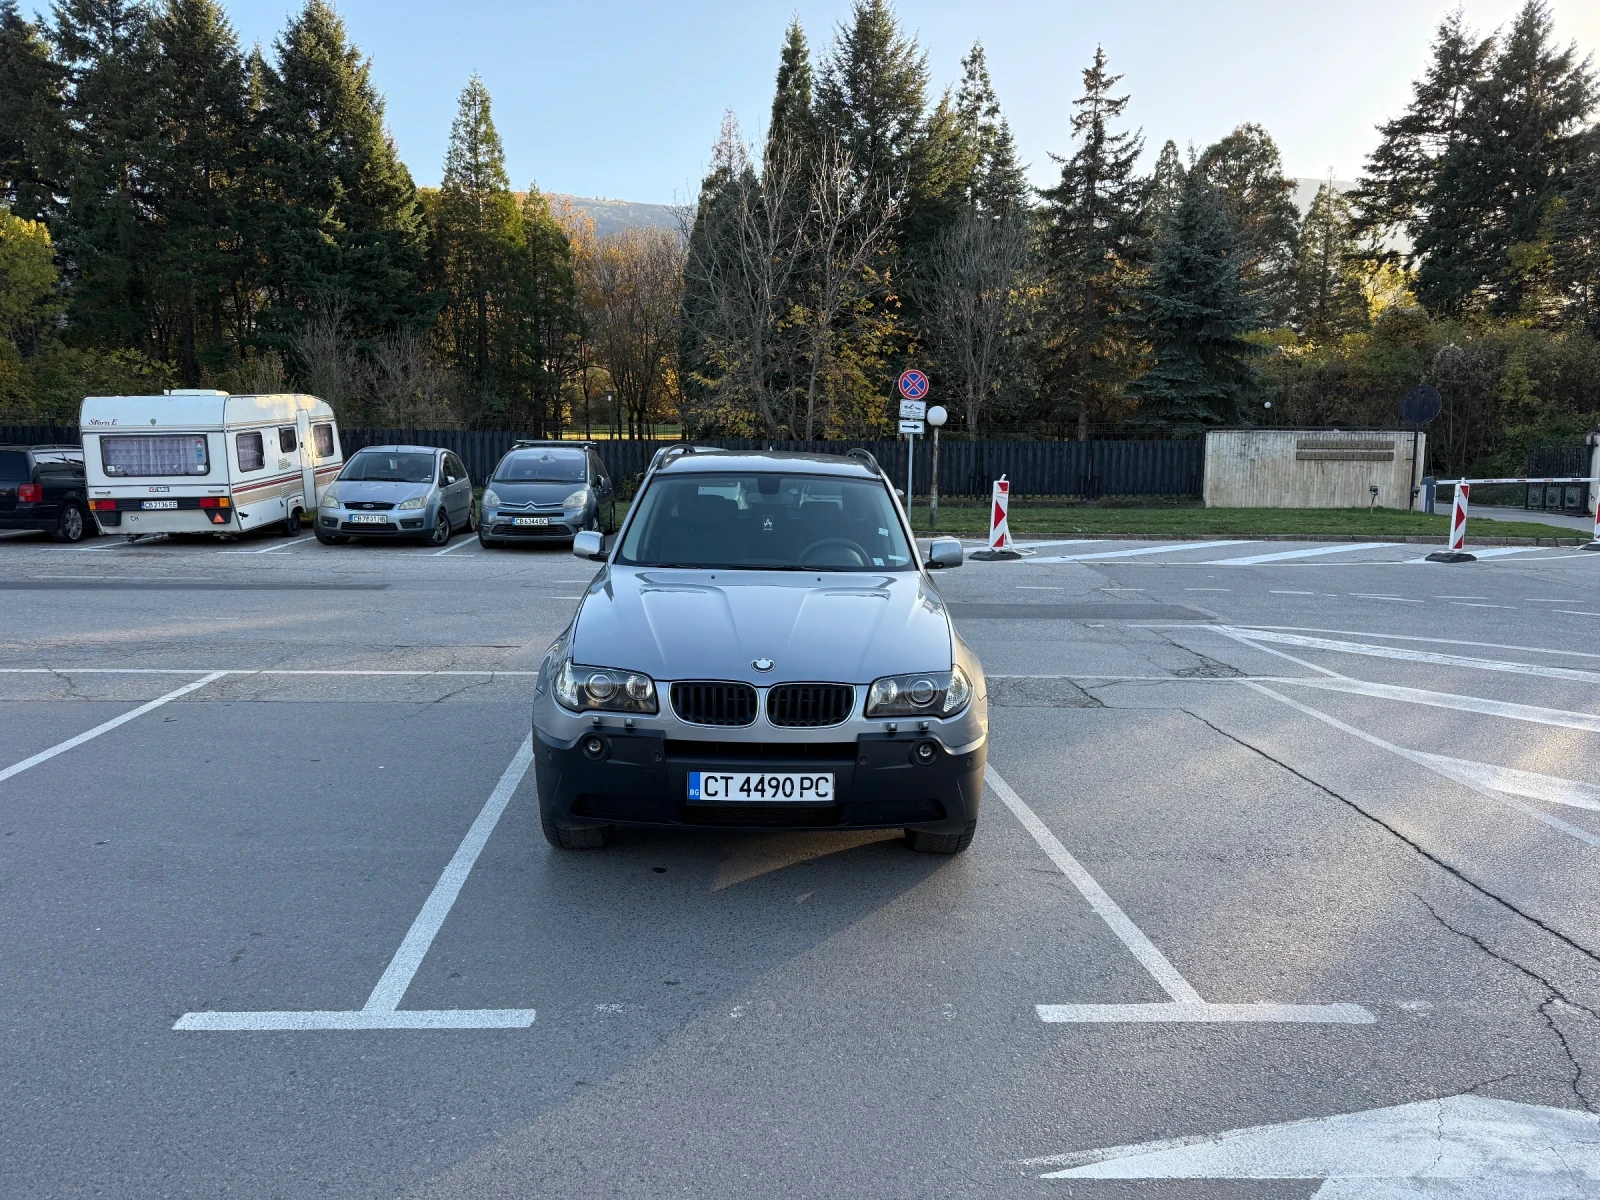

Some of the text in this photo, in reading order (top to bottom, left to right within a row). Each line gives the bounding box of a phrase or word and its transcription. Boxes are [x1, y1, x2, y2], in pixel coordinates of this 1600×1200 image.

[704, 776, 829, 798] CT 4490 PC
